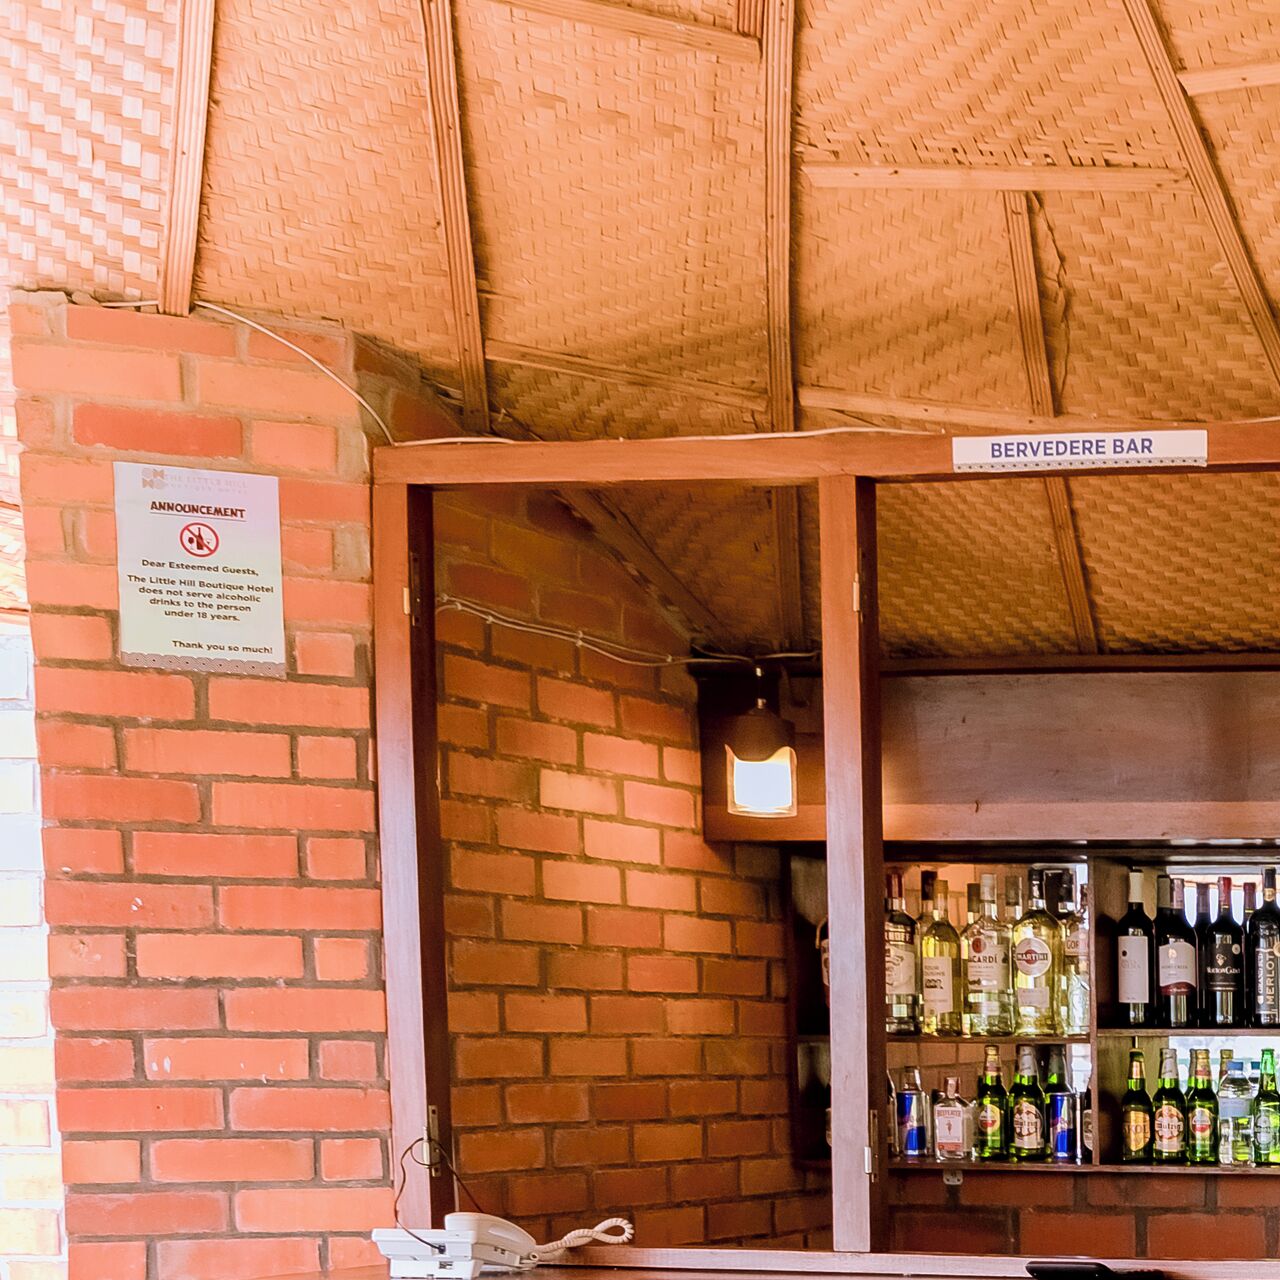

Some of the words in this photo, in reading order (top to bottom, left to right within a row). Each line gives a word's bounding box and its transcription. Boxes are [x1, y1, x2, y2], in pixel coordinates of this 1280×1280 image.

[991, 439, 1106, 459] BERVEDERE
[1112, 438, 1153, 455] BAR
[150, 501, 246, 518] ANNOUNCEMENT
[141, 559, 166, 569] Dear
[168, 562, 219, 573] Esteemed
[222, 566, 259, 577] Guests,
[127, 575, 146, 583] The
[149, 576, 176, 586] Little
[179, 579, 196, 587] Hill
[198, 581, 244, 592] Boutique
[247, 584, 274, 593] Hotel
[138, 586, 163, 595] does
[166, 588, 183, 597] not
[186, 591, 213, 599] serve
[216, 593, 261, 603] alcoholic
[149, 597, 181, 607] drinks
[184, 600, 195, 608] to
[197, 600, 214, 609] the
[217, 603, 251, 613] person
[164, 609, 194, 618] under
[197, 611, 207, 619] 18
[210, 613, 240, 622] years.
[172, 640, 203, 649] Thank
[206, 643, 225, 652] you
[242, 646, 273, 654] much!
[1266, 953, 1275, 1005] MERLOT
